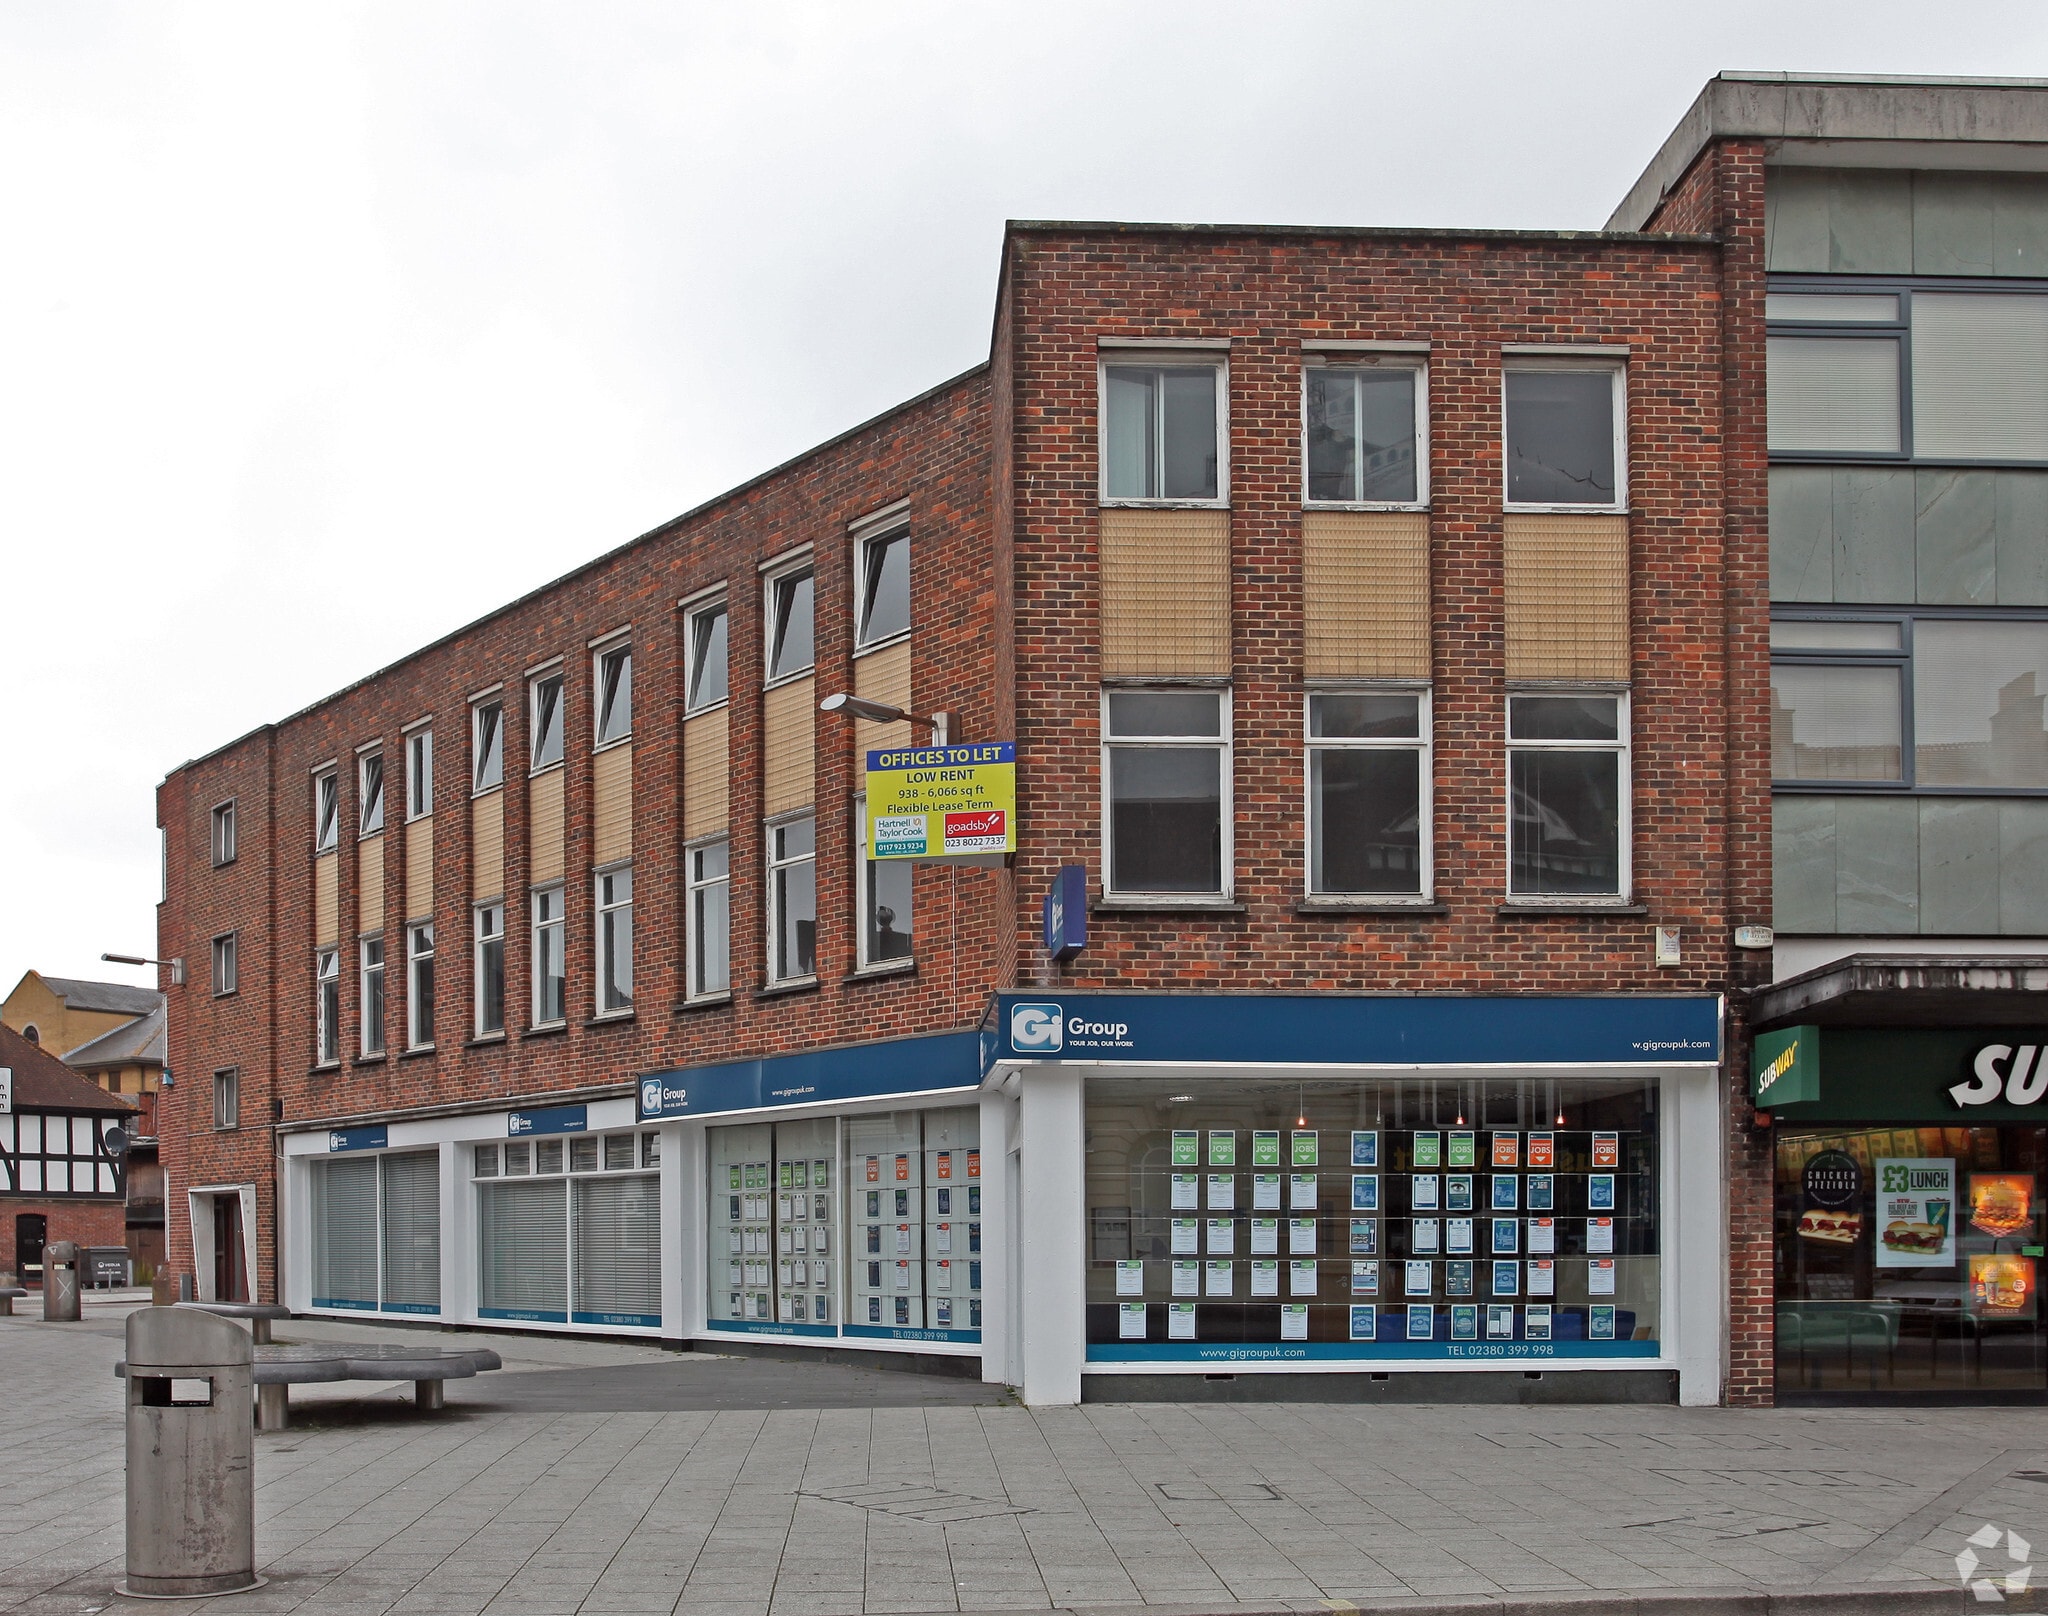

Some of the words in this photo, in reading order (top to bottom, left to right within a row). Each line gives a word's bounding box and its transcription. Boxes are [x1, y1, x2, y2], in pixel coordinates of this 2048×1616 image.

[879, 749, 945, 767] OFFICES
[948, 748, 970, 763] TO
[973, 746, 1002, 761] LET
[906, 772, 936, 784] LOW
[940, 769, 976, 782] RENT
[898, 789, 918, 799] 938
[928, 786, 958, 798] 6,066
[961, 787, 972, 798] sq
[975, 785, 984, 795] ft
[887, 802, 930, 814] Flexible
[932, 801, 964, 812] Lease
[966, 800, 993, 811] Term
[878, 818, 911, 828] Hartnell
[946, 819, 991, 835] goadsby
[878, 829, 902, 838] Taylor
[902, 828, 924, 836] Cook
[945, 838, 960, 848] 023
[962, 838, 984, 847] 8022
[985, 836, 1006, 845] 7337
[1013, 1008, 1062, 1046] Gi
[1068, 1017, 1128, 1041] Group
[1632, 1038, 1711, 1051] w.gigroupuk.com
[1758, 1040, 1798, 1094] SUBWAY
[1948, 1044, 2048, 1108] SU
[772, 1085, 815, 1097] www.gigroupuk.com
[643, 1084, 662, 1110] Gi
[663, 1087, 686, 1102] Group
[1175, 1145, 1196, 1153] JOBS
[1211, 1145, 1233, 1153] JOBS
[1416, 1146, 1437, 1154] JOBS
[1451, 1146, 1472, 1154] JOBS
[1495, 1146, 1516, 1154] JOBS
[1530, 1146, 1551, 1154] JOBS
[1595, 1146, 1616, 1154] JOBS
[1808, 1171, 1856, 1180] CHICKEN
[1882, 1165, 1910, 1193] £3
[1910, 1172, 1949, 1188] LUNCH
[1808, 1181, 1856, 1190] PIZZIOLA
[748, 1325, 794, 1335] www.gigroupuk.com
[892, 1330, 902, 1339] TEL
[903, 1330, 922, 1340] 02380
[923, 1331, 935, 1340] 399
[936, 1332, 948, 1341] 998
[1200, 1347, 1306, 1360] www.gigroupuk.com
[1446, 1346, 1465, 1356] TEL
[1468, 1345, 1504, 1355] 02380
[1508, 1345, 1529, 1355] 399
[1532, 1345, 1554, 1355] 998
